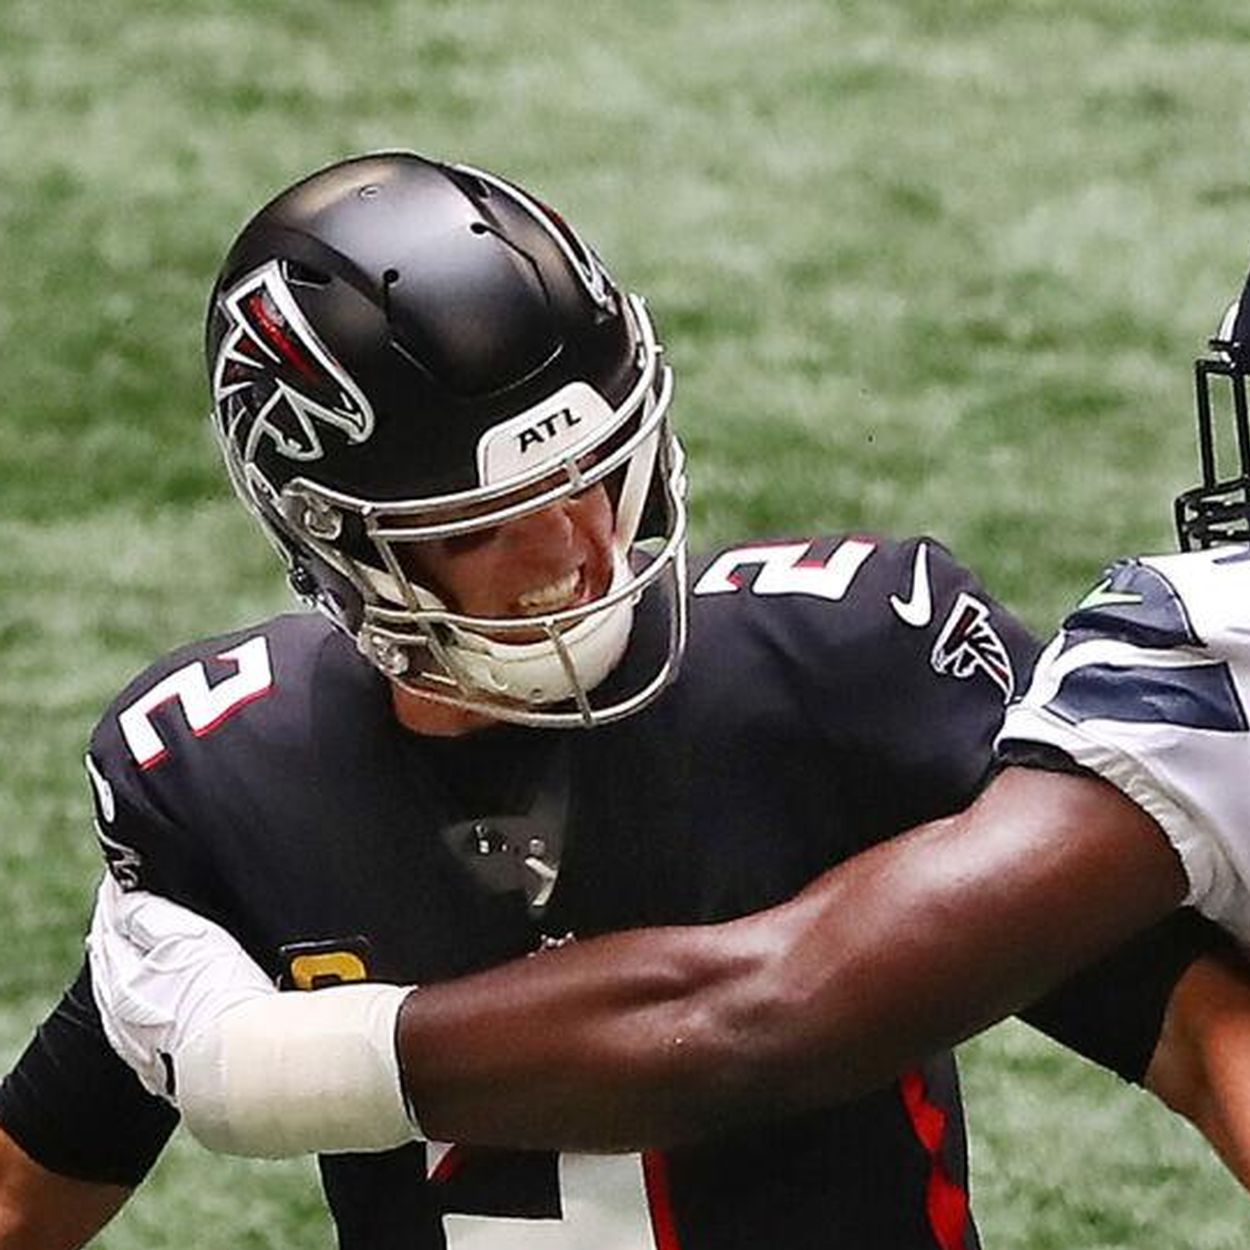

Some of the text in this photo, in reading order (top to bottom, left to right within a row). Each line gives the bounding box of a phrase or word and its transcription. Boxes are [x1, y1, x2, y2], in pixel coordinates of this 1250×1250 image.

[517, 408, 582, 453] ATL
[693, 535, 883, 601] 2
[118, 634, 279, 771] 2
